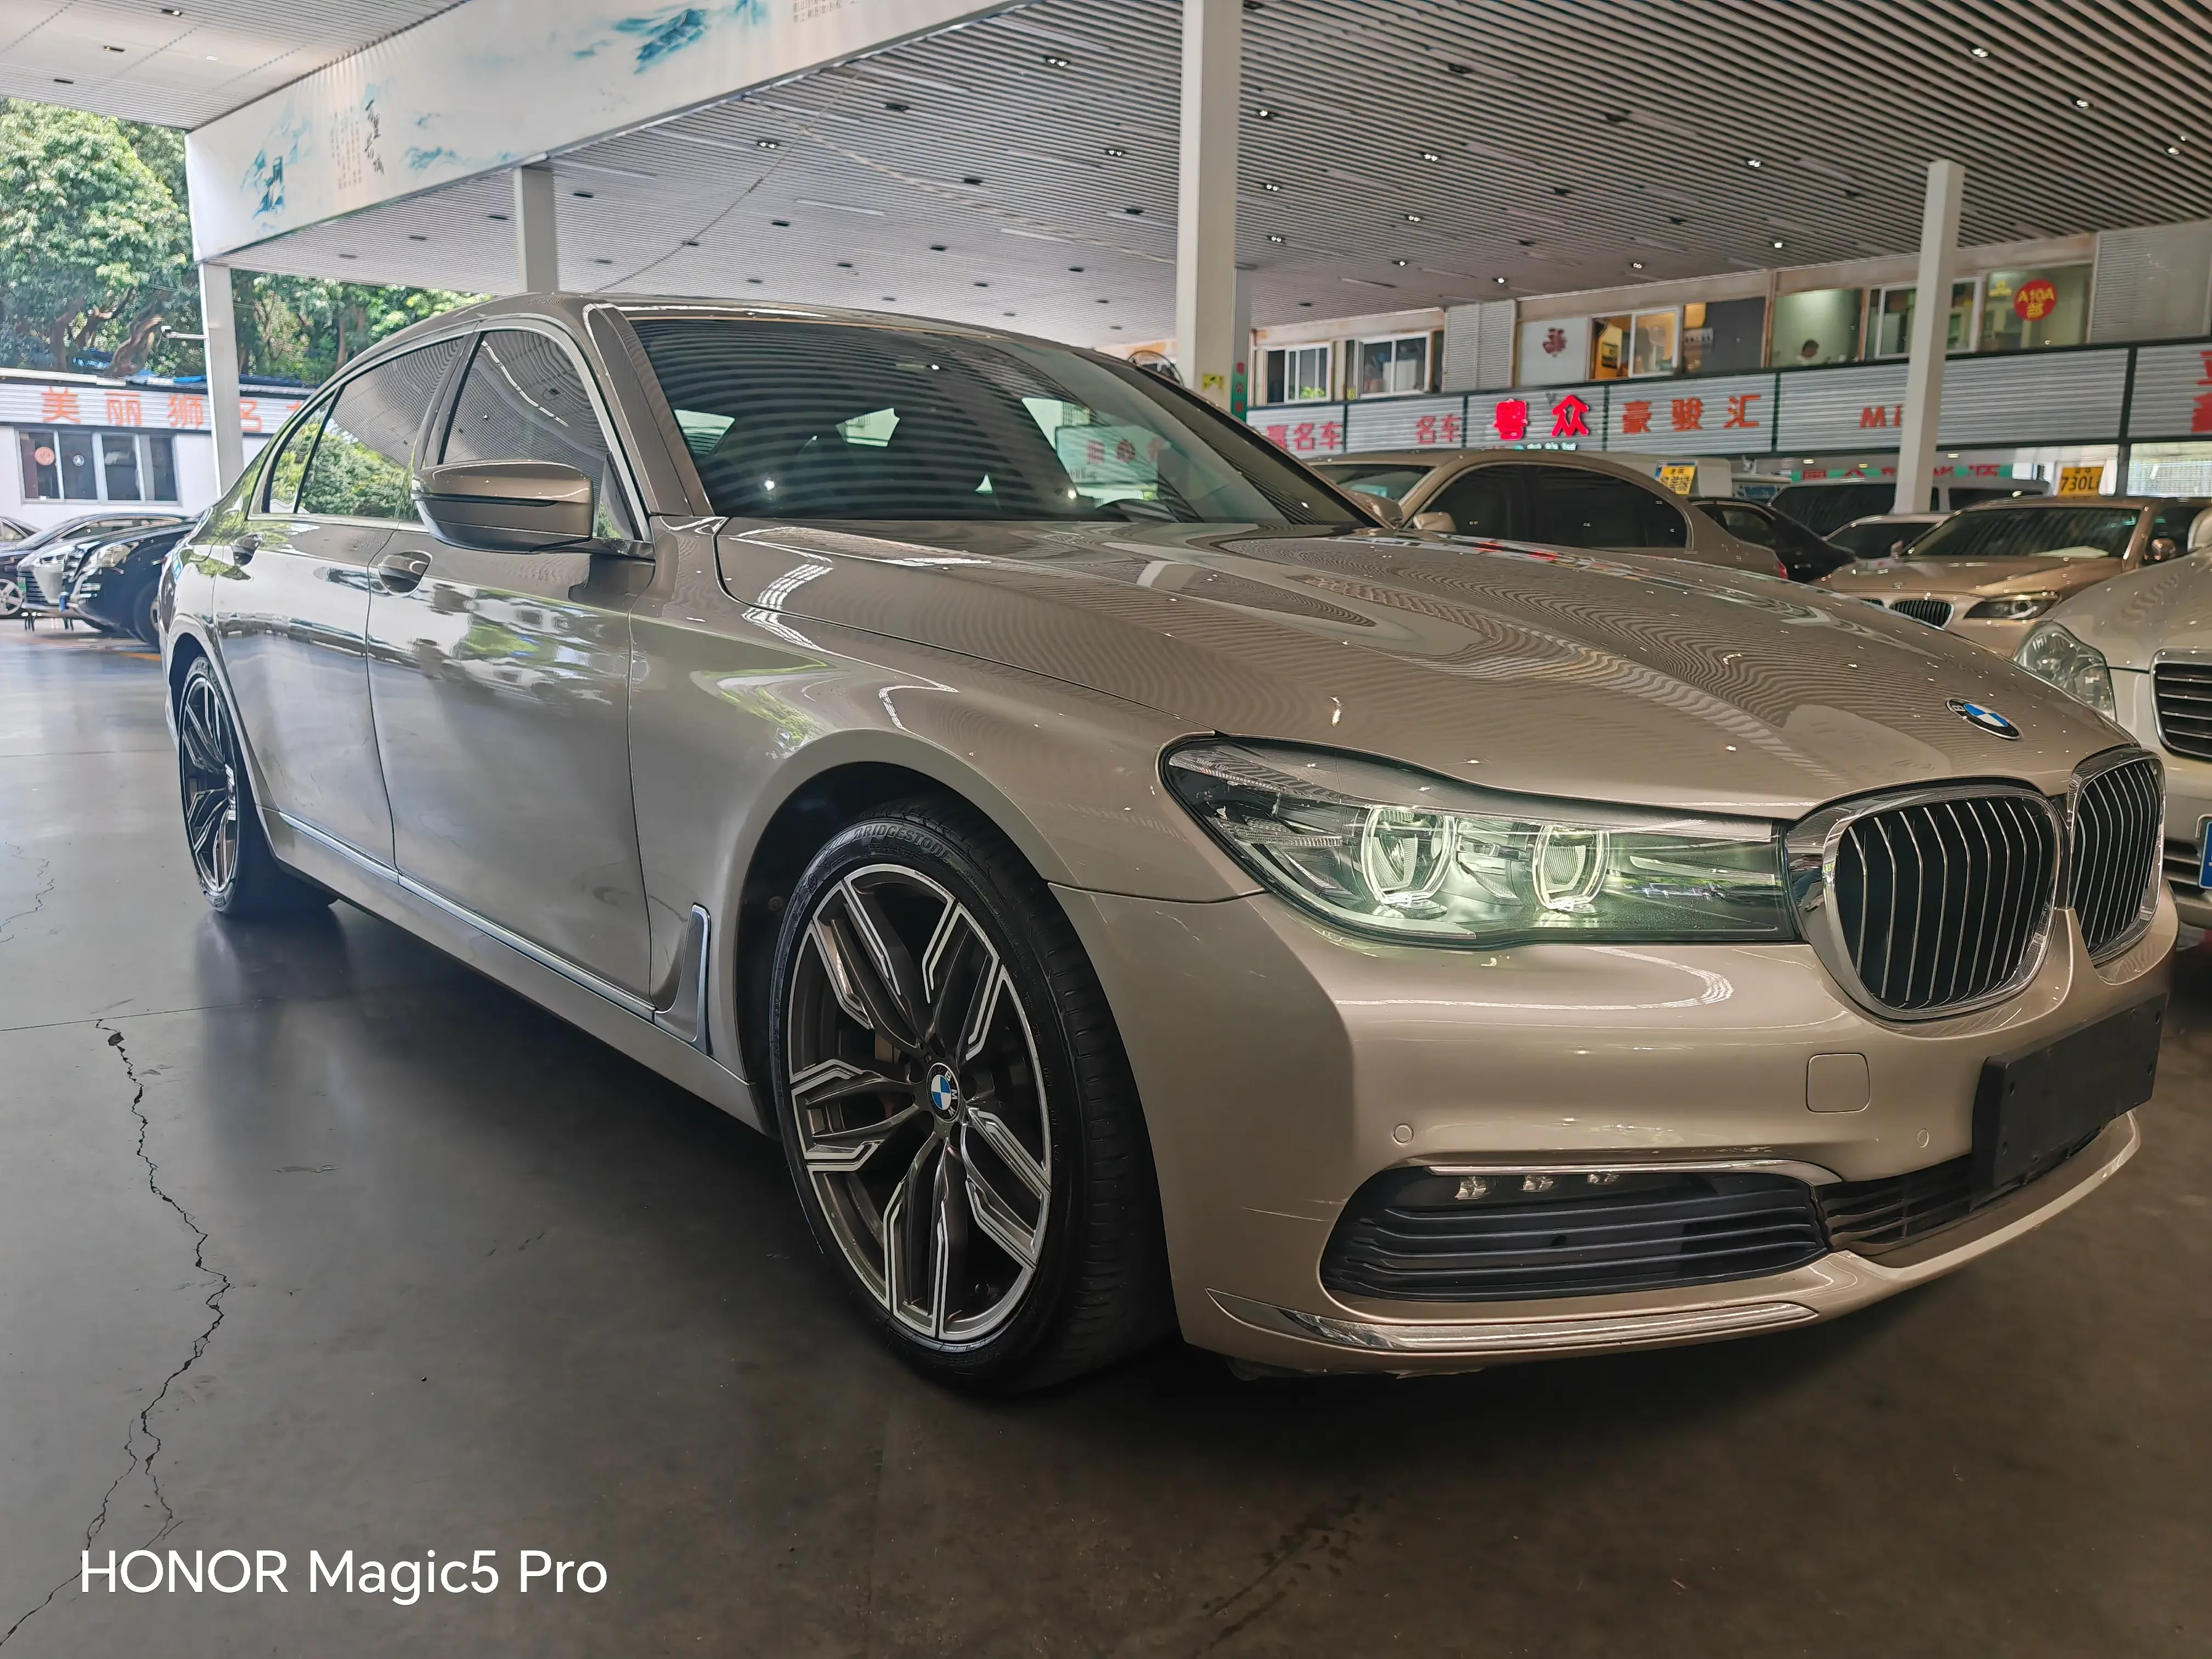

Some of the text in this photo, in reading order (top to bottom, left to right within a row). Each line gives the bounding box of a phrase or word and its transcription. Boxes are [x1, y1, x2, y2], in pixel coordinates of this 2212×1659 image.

[1196, 758, 1215, 768] BMW
[853, 824, 953, 864] BRIDGESTONE
[944, 1070, 958, 1117] BMW
